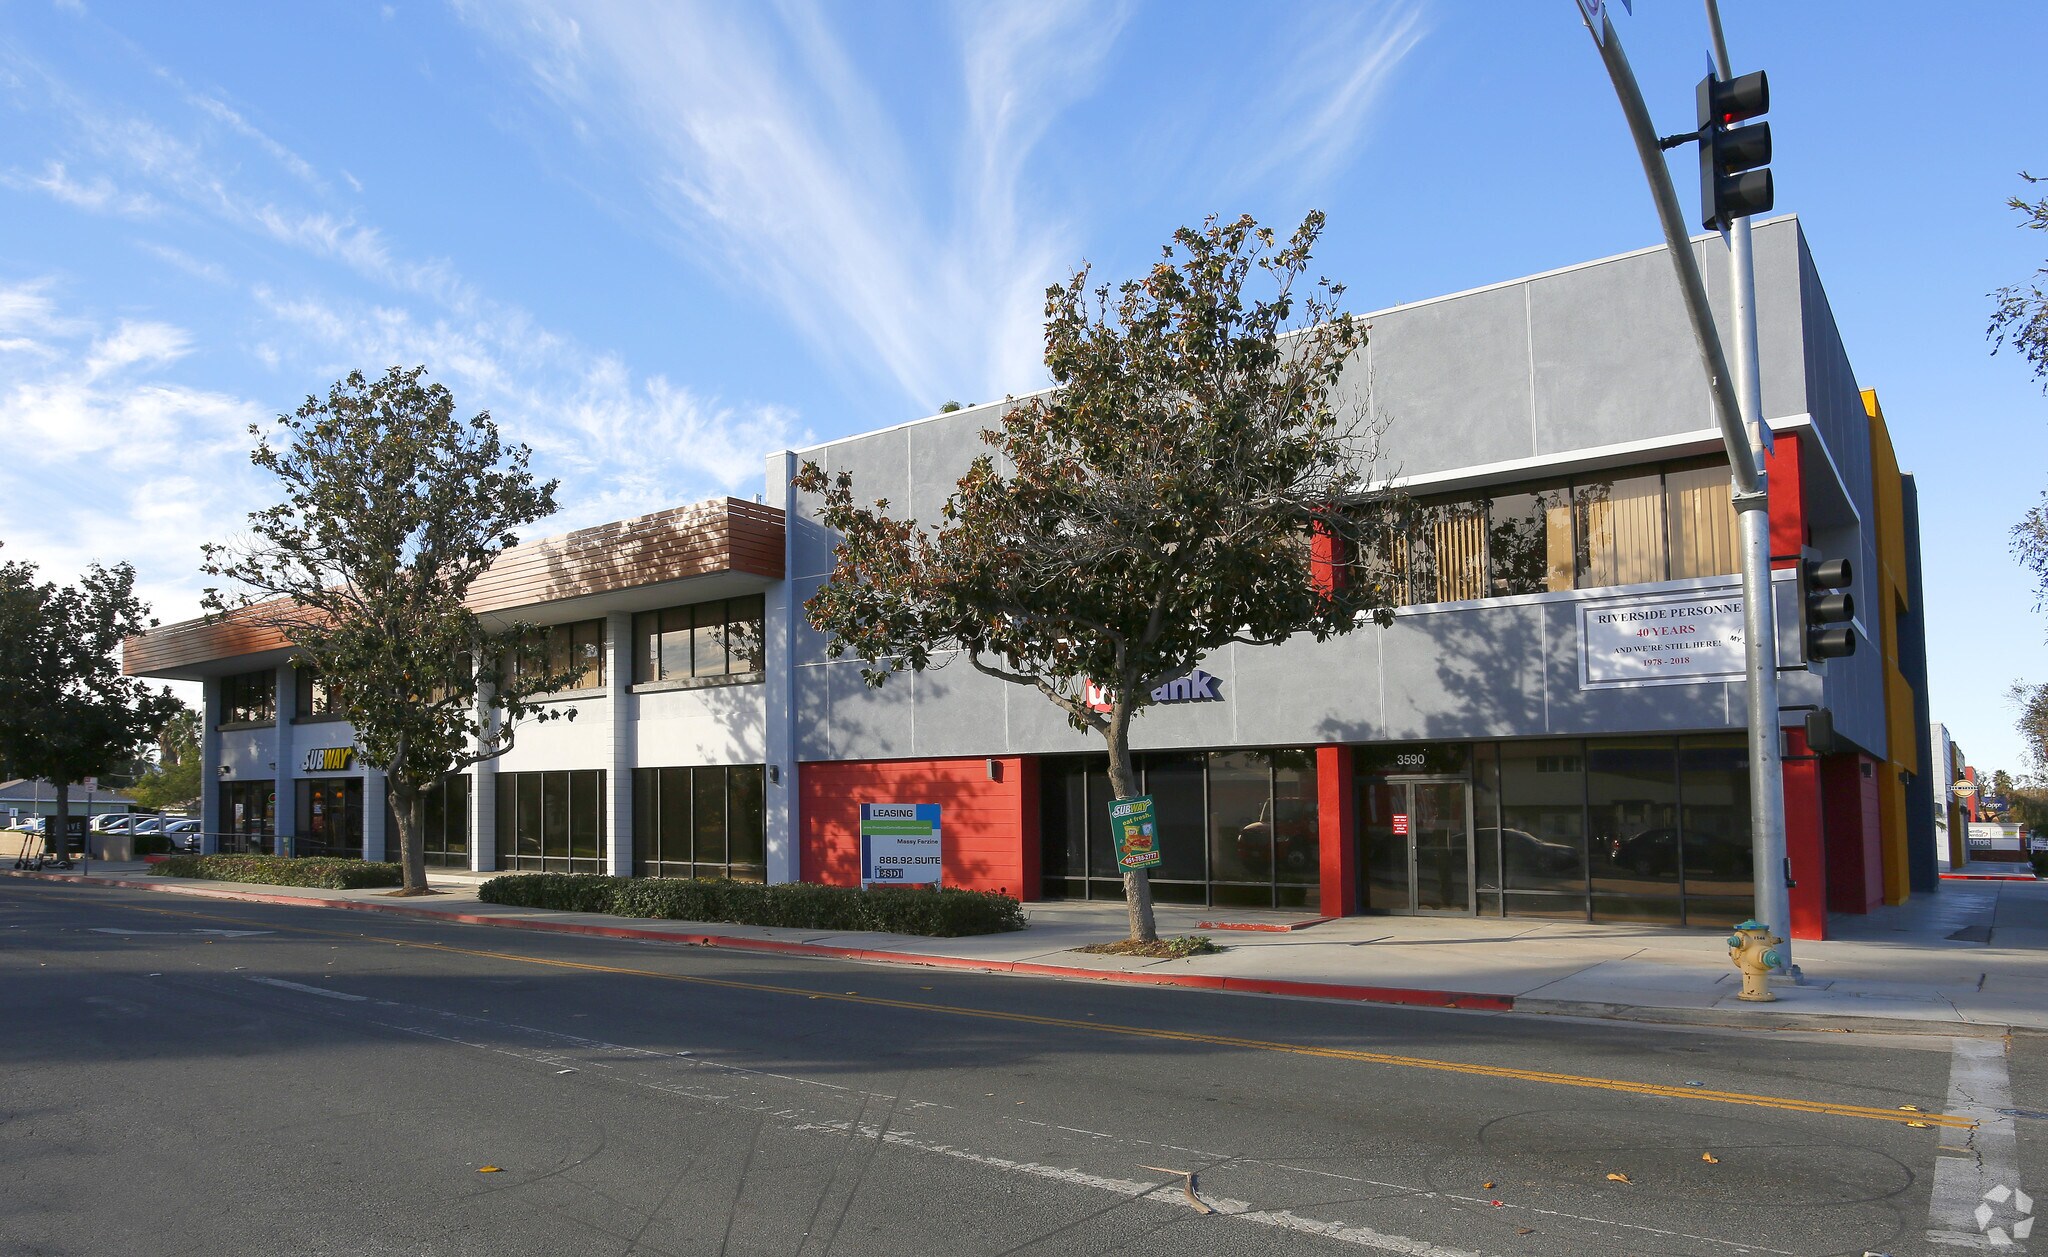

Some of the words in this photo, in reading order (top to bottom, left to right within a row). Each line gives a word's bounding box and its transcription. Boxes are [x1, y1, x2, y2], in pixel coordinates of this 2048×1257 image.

[1598, 609, 1667, 624] RIVERSIDE
[1671, 603, 1743, 618] PERSONNE
[1636, 627, 1650, 638] 40
[1652, 624, 1696, 636] YEARS
[1613, 646, 1632, 654] AND
[1634, 644, 1663, 652] WE'RE
[1665, 641, 1692, 651] STILL
[1693, 640, 1722, 648] HERE!
[1643, 658, 1663, 667] 1978
[1670, 656, 1690, 665] 2018
[1151, 670, 1214, 702] ank
[302, 747, 352, 771] SUBWAY
[1397, 754, 1425, 765] 3590
[873, 809, 914, 818] LEASING
[1113, 800, 1152, 817] SUBWAY
[1122, 818, 1133, 826] eat
[1133, 813, 1152, 822] fresh.
[879, 856, 941, 865] 888.92.SUITE
